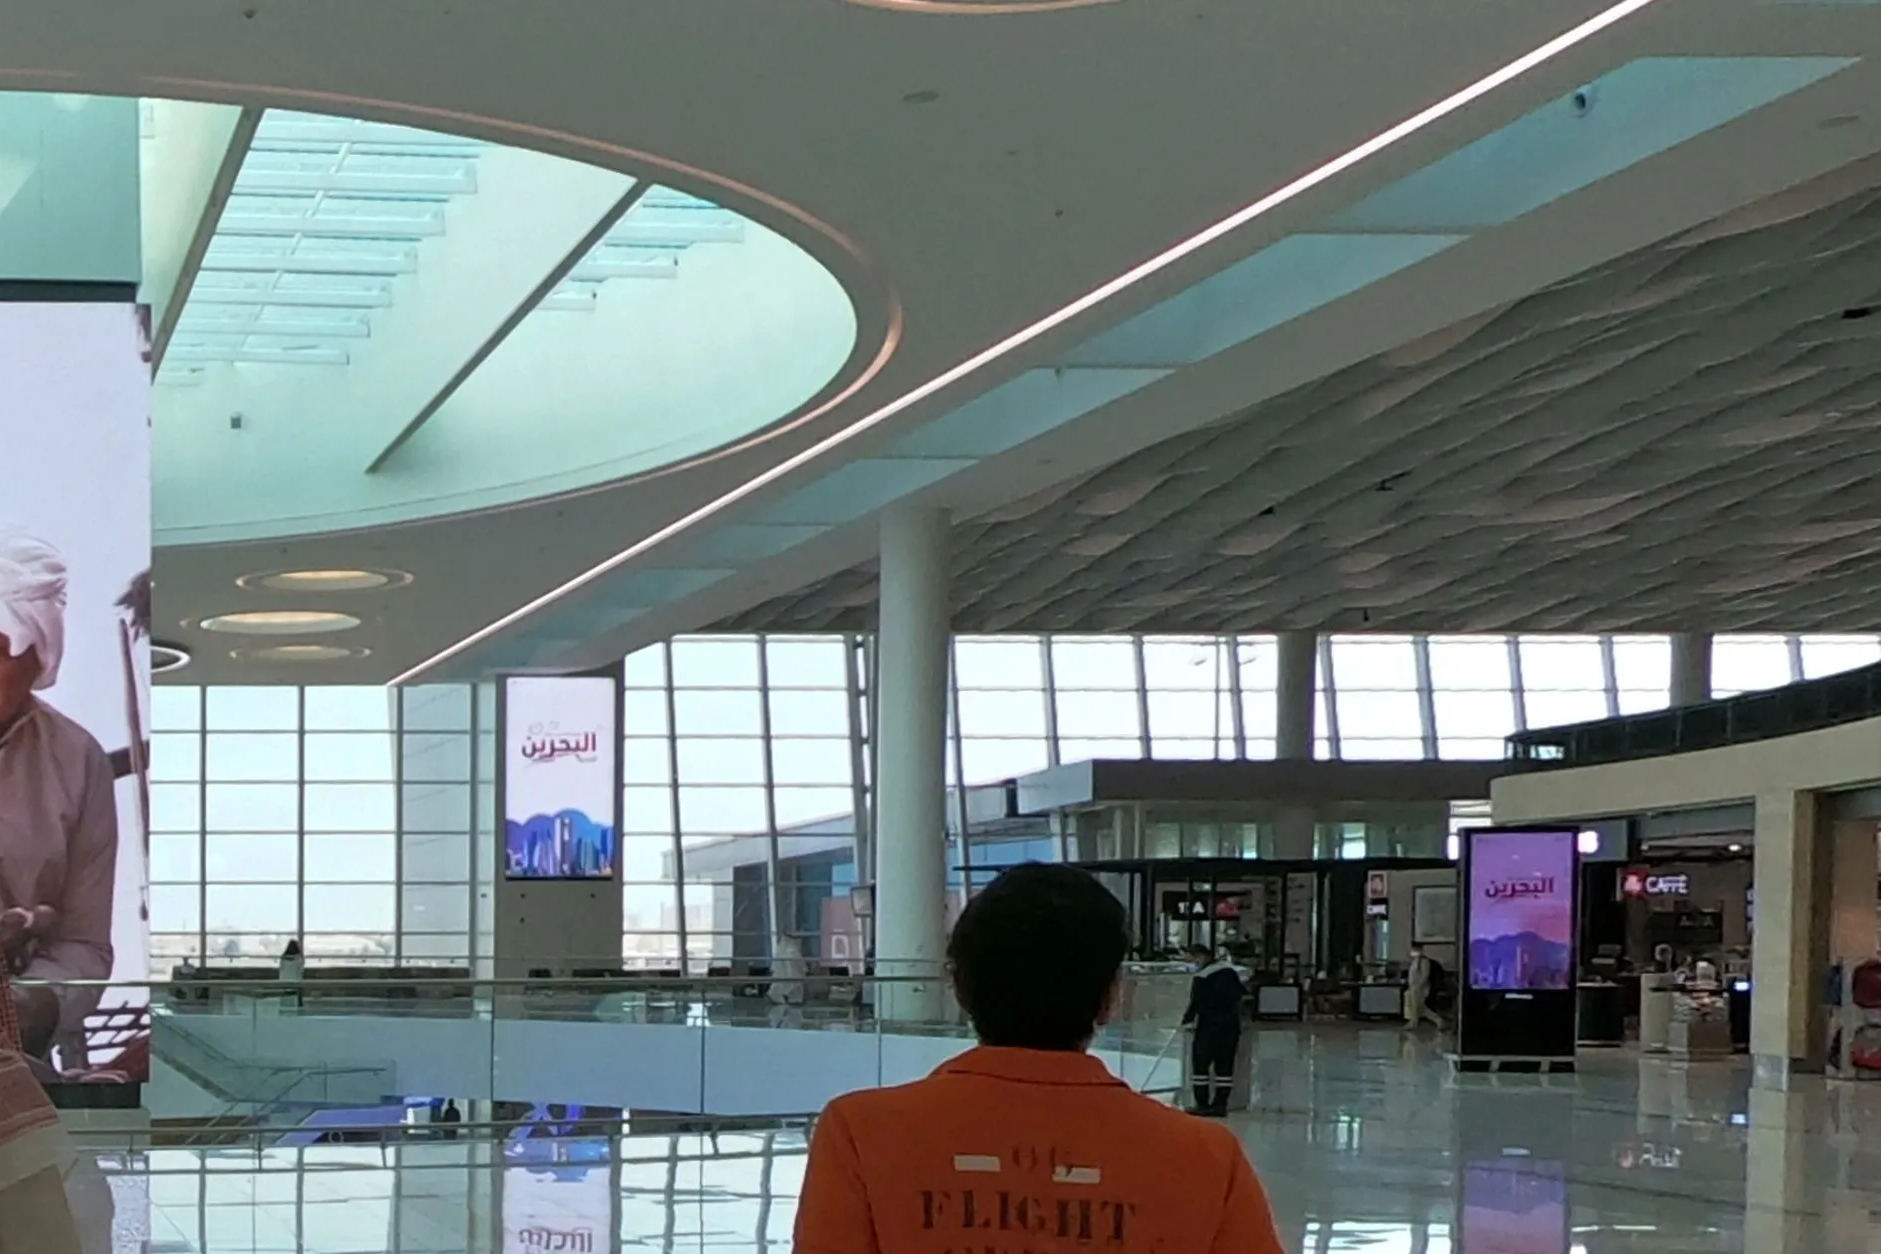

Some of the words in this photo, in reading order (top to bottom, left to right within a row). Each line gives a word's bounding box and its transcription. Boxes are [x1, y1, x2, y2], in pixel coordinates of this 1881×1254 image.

[521, 731, 597, 760] البحرين
[1484, 876, 1556, 900] البحرين
[920, 1189, 1136, 1243] FLIGHT
